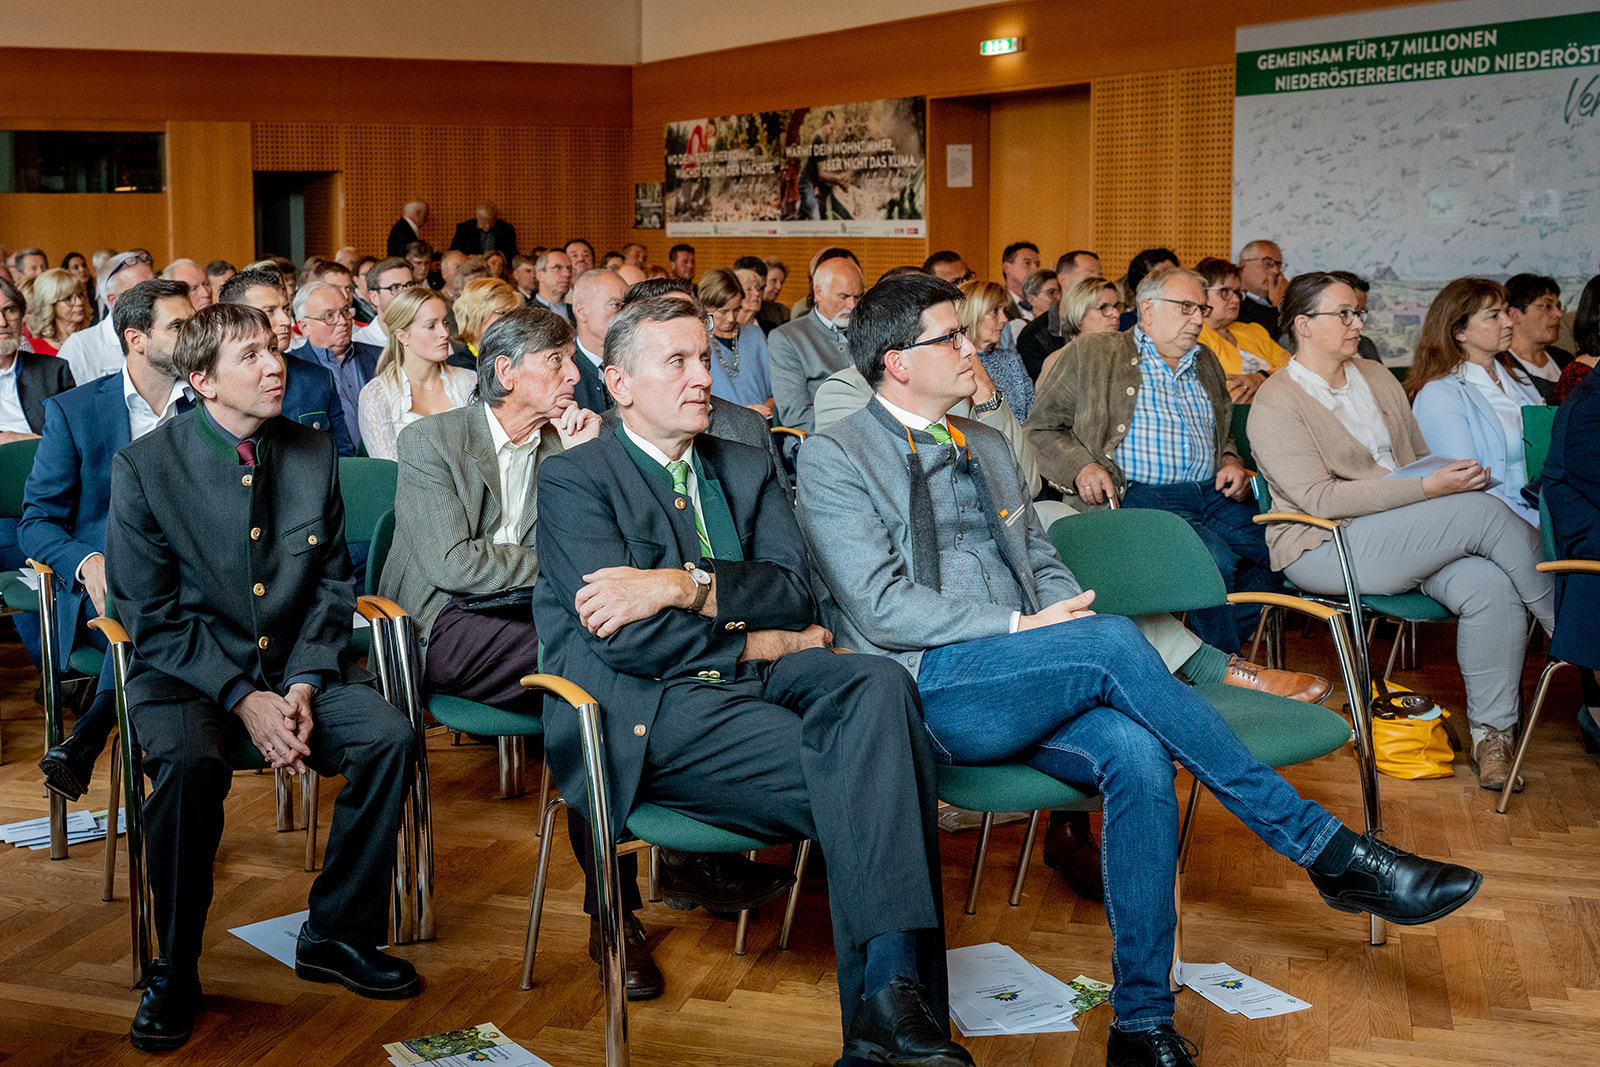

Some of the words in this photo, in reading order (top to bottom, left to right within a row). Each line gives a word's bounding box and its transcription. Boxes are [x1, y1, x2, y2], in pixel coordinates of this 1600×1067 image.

[1257, 49, 1343, 70] GEMEINSAM
[1346, 41, 1377, 61] FÜR
[1380, 41, 1400, 62] 1,7
[1403, 29, 1498, 56] MILLIONEN
[1275, 59, 1447, 91] NIEDERÖSTERREICHER
[1452, 55, 1490, 75] UND
[871, 156, 887, 169] DAS
